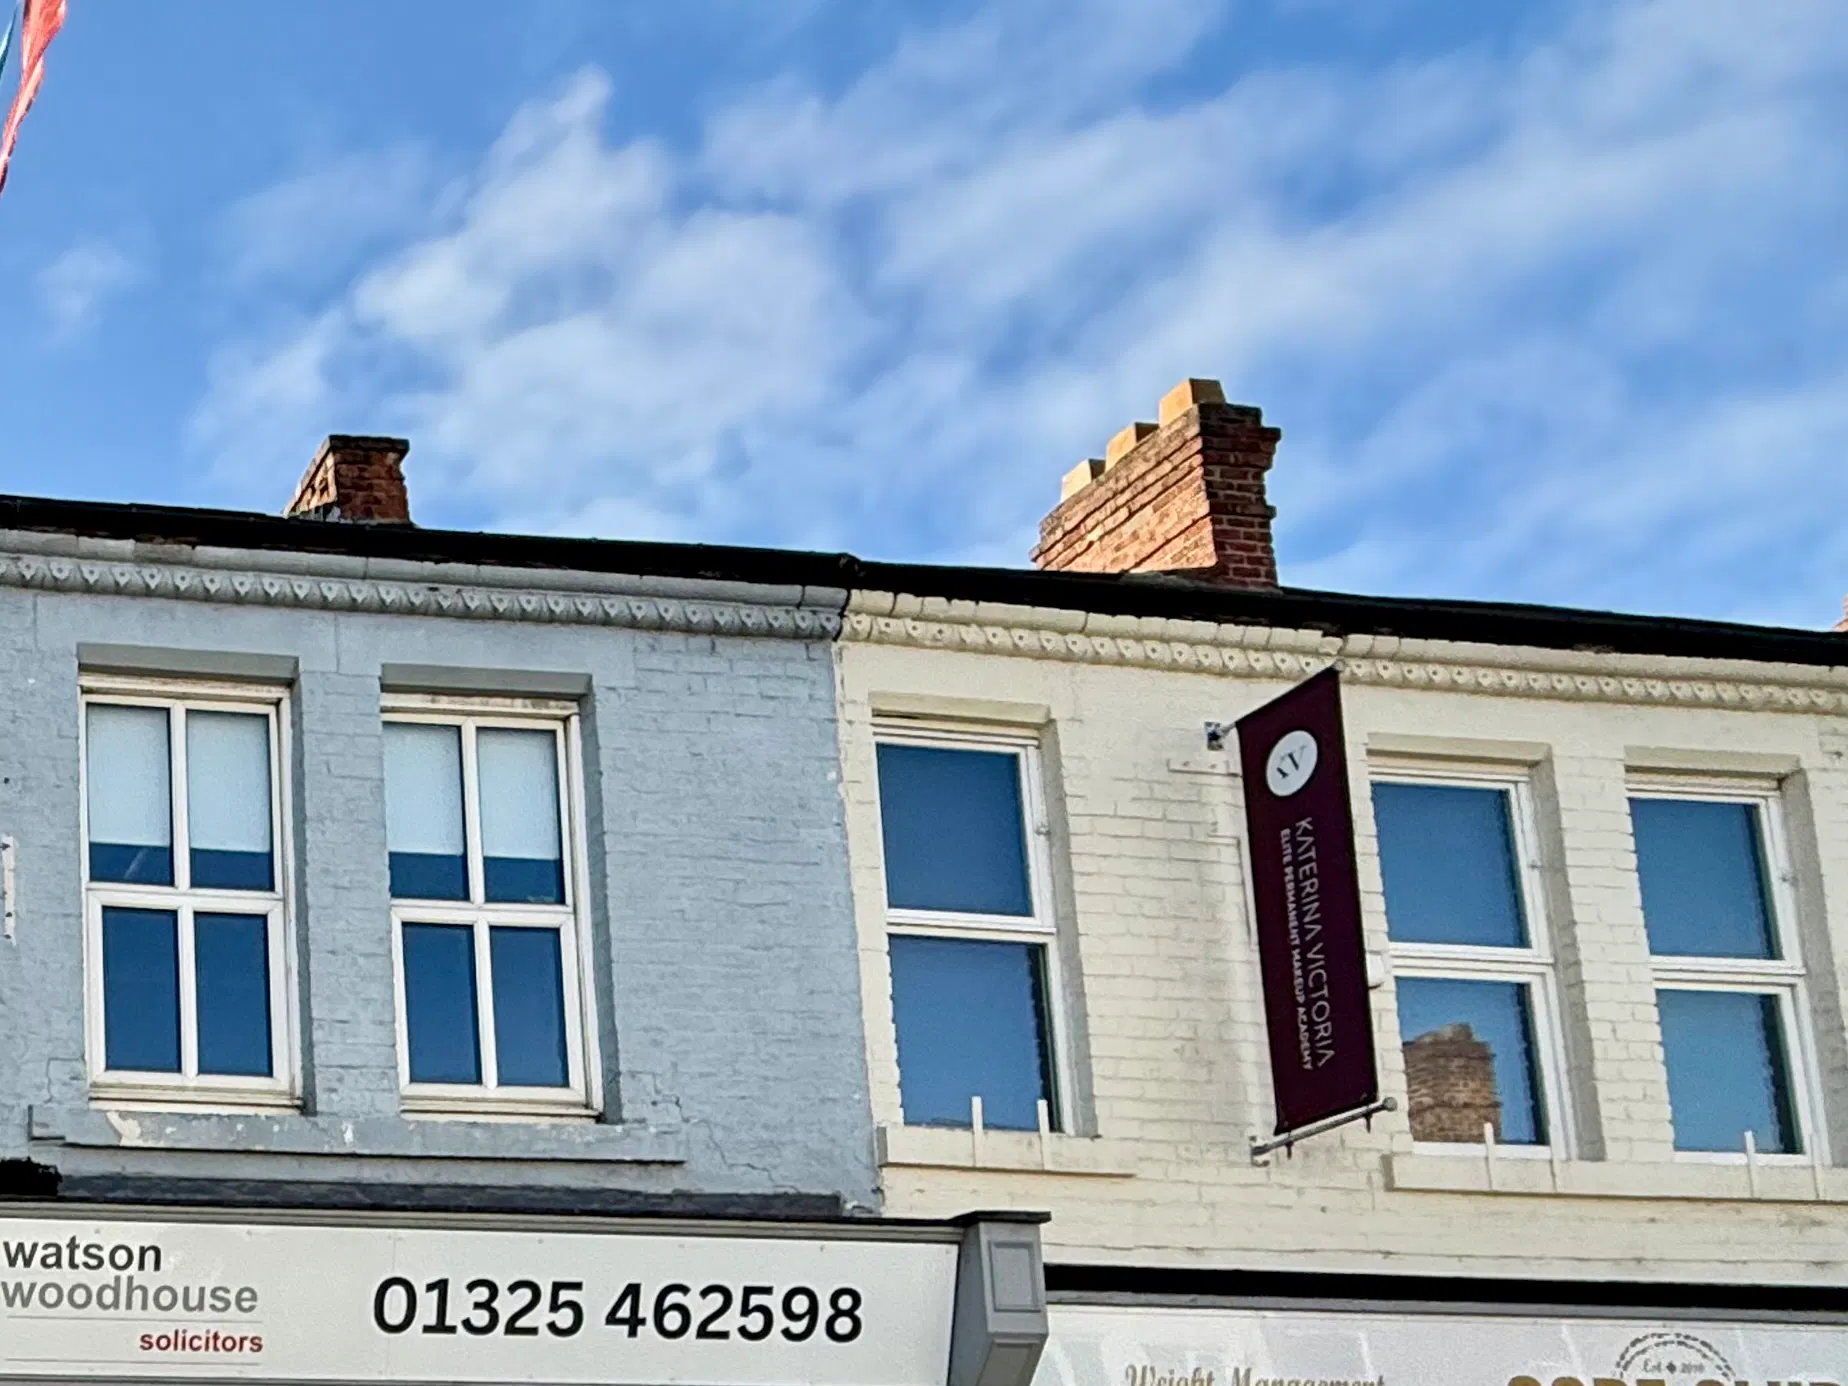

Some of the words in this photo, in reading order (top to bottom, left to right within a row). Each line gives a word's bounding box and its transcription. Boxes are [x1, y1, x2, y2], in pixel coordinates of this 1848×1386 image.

[1295, 816, 1323, 941] KATERINA
[1306, 942, 1335, 1068] VICTORIA
[3, 1235, 162, 1272] watson
[0, 1275, 259, 1314] woodhouse
[372, 1276, 585, 1338] 01325
[605, 1282, 863, 1344] 462598
[139, 1329, 264, 1353] solicitors
